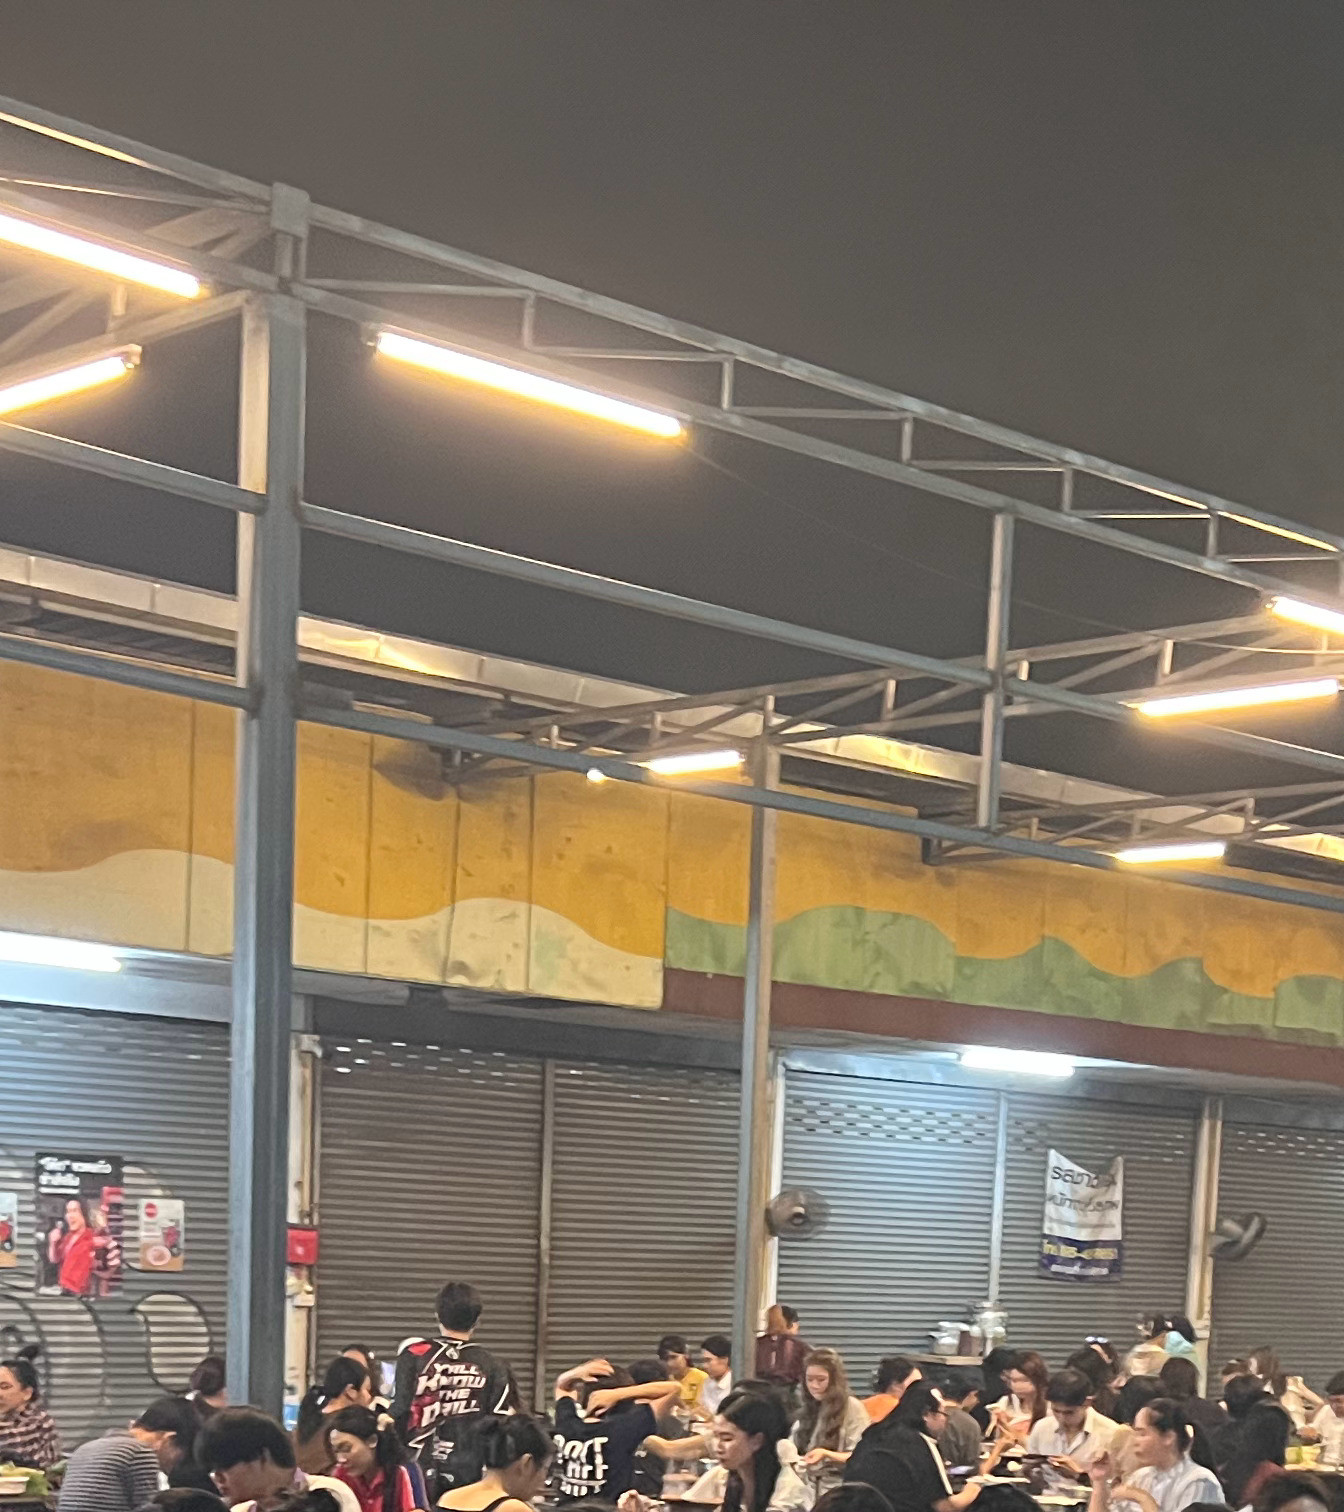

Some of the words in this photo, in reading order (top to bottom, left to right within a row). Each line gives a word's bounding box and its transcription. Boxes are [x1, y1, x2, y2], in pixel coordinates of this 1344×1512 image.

[416, 1373, 487, 1396] KNOW
[438, 1388, 471, 1400] THE
[421, 1399, 480, 1428] DRILL
